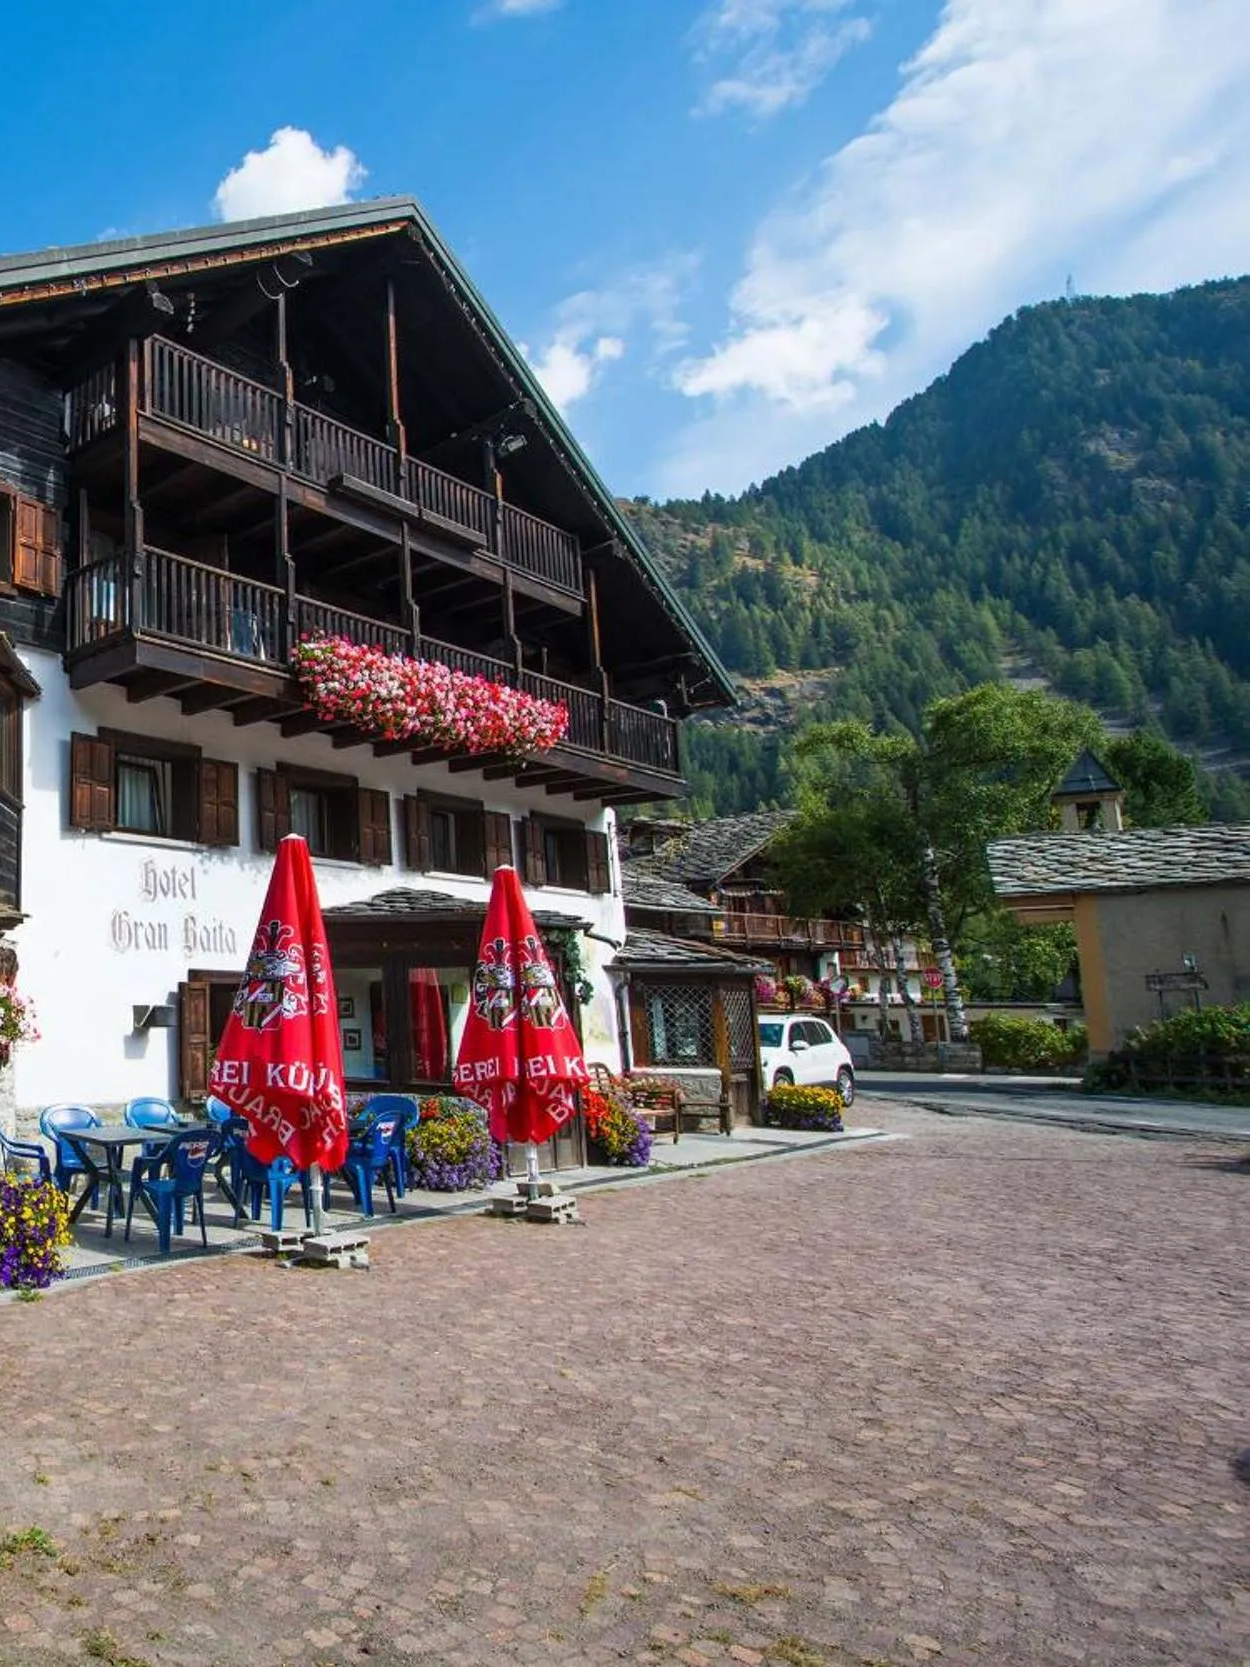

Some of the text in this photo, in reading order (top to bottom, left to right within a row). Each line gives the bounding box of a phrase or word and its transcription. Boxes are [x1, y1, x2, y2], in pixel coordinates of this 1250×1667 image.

[140, 857, 196, 902] Hotel
[110, 908, 237, 958] Gran Baita
